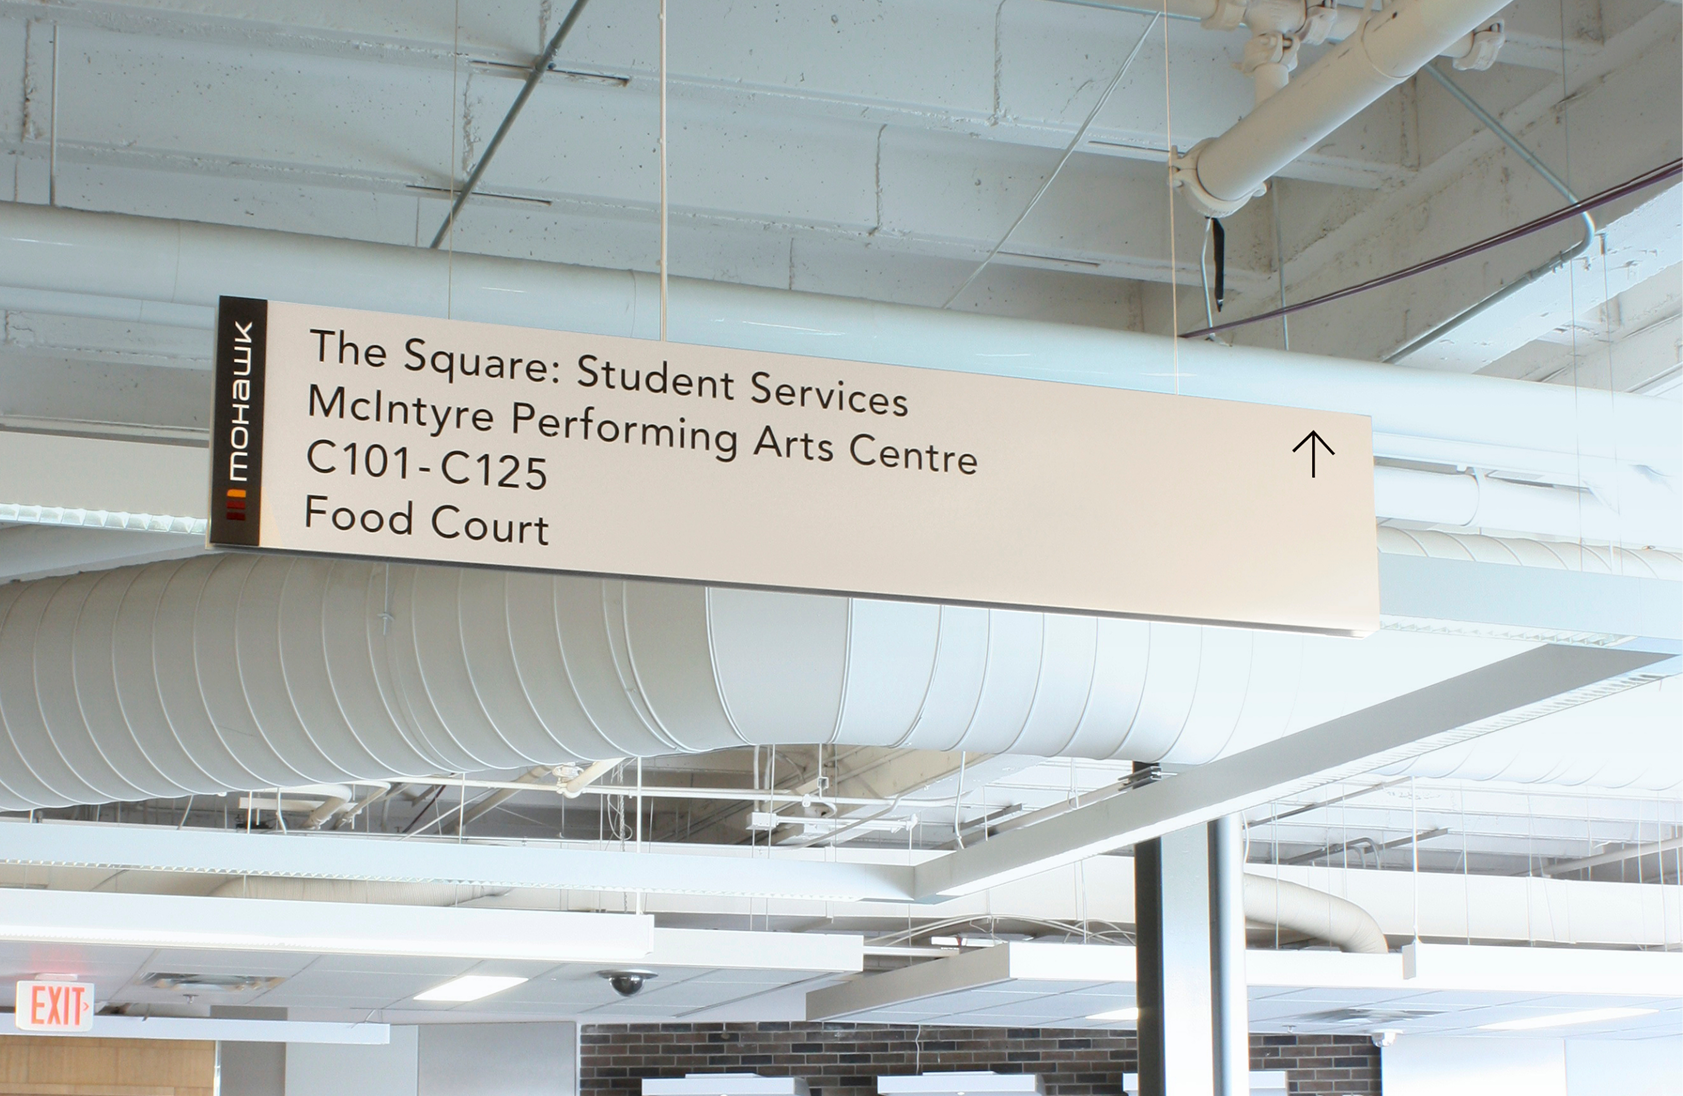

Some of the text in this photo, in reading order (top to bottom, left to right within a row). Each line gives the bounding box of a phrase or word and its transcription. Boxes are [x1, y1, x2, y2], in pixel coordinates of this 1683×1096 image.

[310, 329, 909, 417] The Square: Student Services
[309, 384, 978, 475] McIntyre Performing Arts Centre
[305, 494, 549, 546] Food Court
[31, 985, 85, 1026] EXIT
